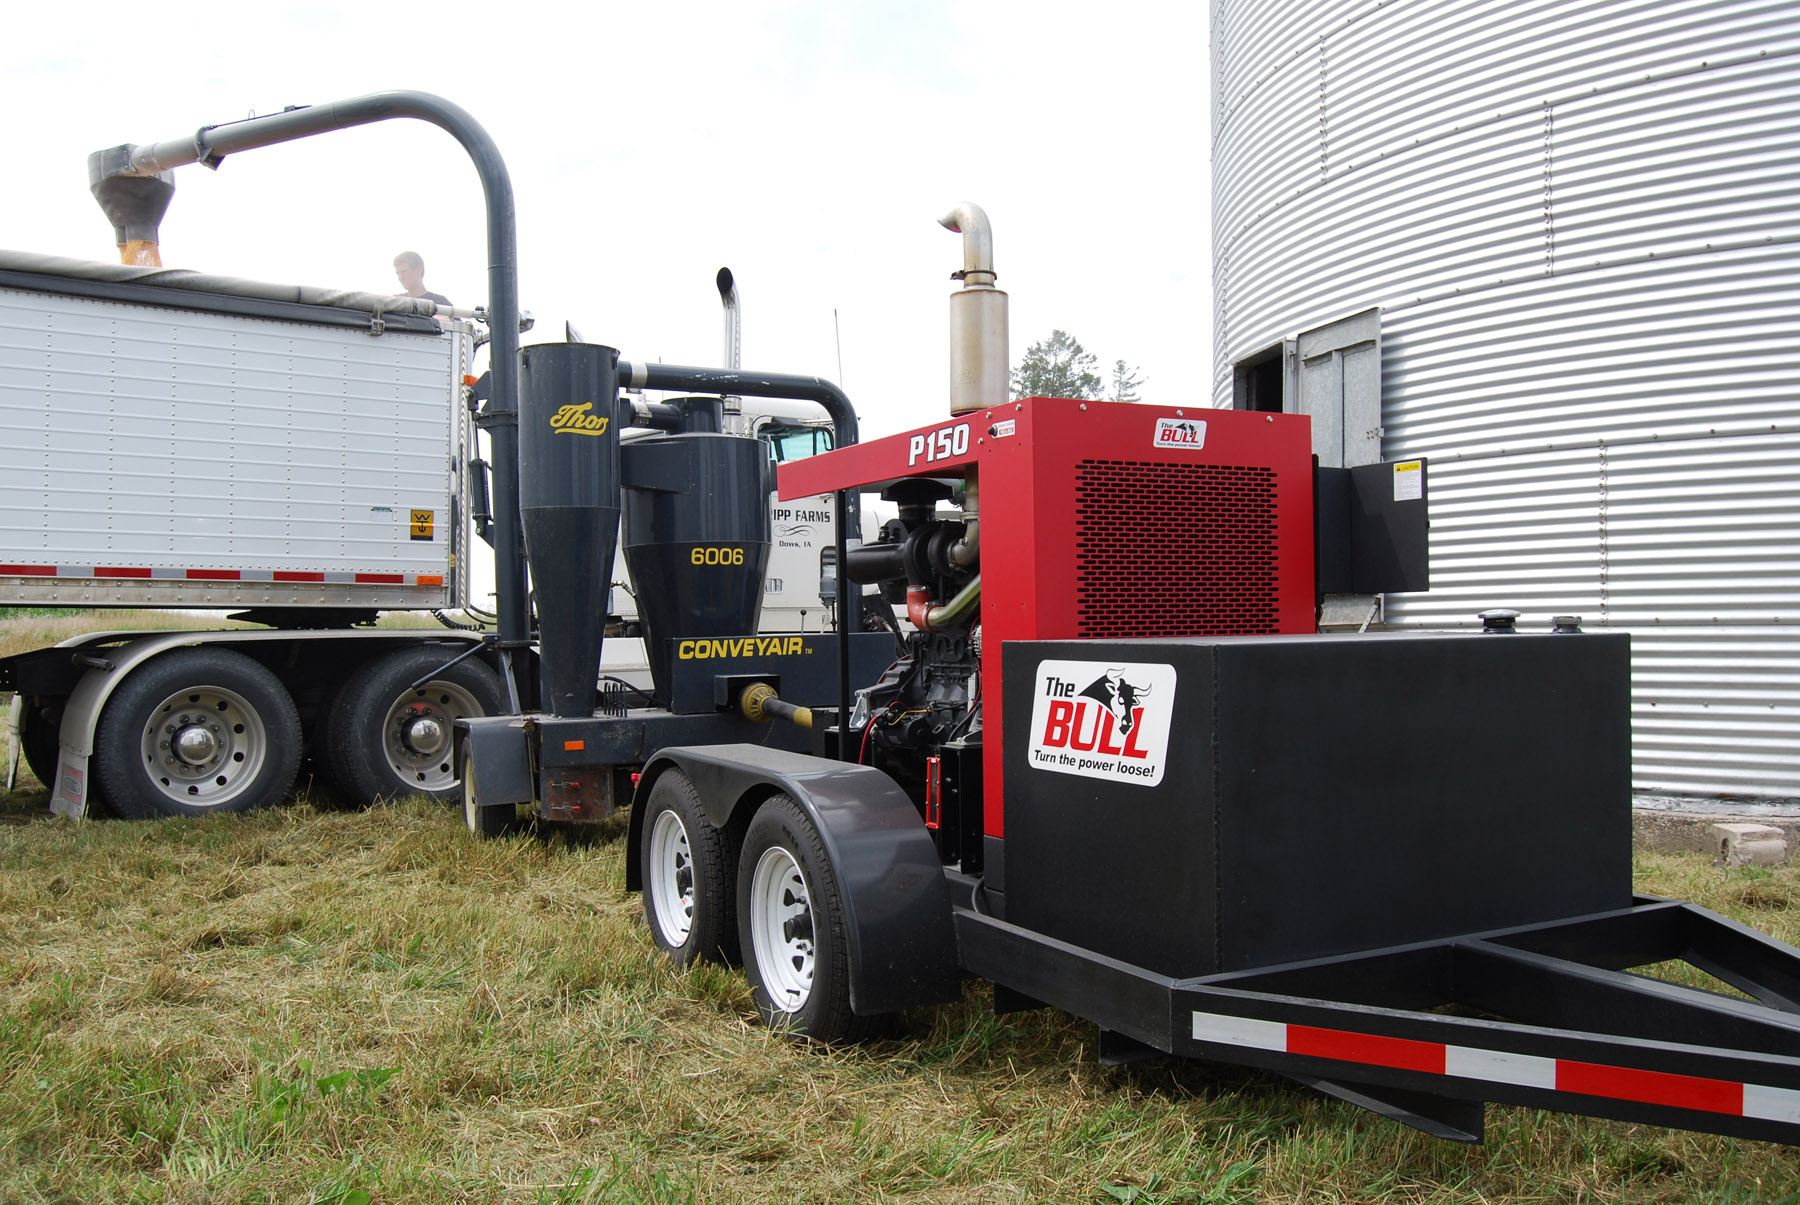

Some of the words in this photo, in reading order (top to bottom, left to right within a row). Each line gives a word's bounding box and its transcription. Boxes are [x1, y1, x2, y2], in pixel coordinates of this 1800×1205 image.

[550, 402, 609, 436] Thor
[908, 423, 969, 467] P150
[1160, 429, 1199, 443] BULL
[771, 509, 791, 520] IPP
[795, 510, 830, 522] FARMS
[779, 540, 801, 548] Dows,
[691, 548, 744, 565] 6006
[678, 637, 803, 659] CONVEYAIR
[1046, 677, 1075, 698] The
[1042, 700, 1149, 759] BULL
[1034, 750, 1056, 763] Turn
[1059, 753, 1076, 766] the
[1078, 757, 1114, 772] power
[1117, 761, 1155, 777] loose!
